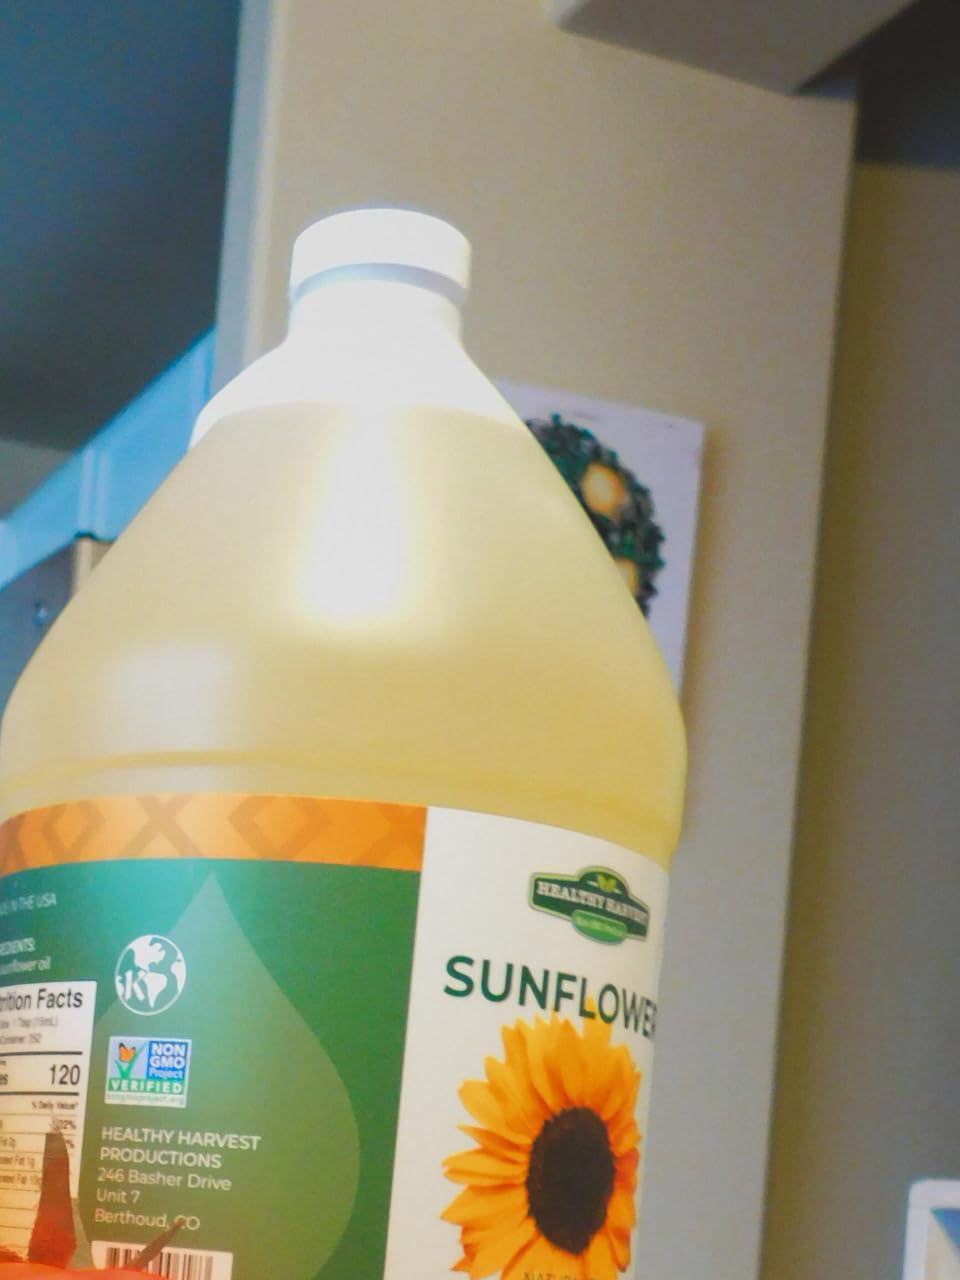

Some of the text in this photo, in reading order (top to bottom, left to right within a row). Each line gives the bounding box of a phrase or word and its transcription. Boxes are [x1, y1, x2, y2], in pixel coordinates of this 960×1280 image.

[538, 881, 606, 909] HEALTHY
[37, 988, 83, 1009] Facts
[151, 1042, 186, 1056] NON
[149, 1056, 185, 1069] GMO
[49, 1064, 80, 1086] 120
[111, 1080, 183, 1094] VERIFIED
[101, 1126, 261, 1151] HEALTHY HARVEST
[100, 1147, 222, 1169] PRODUCTIONS
[97, 1168, 232, 1191] 246 Basher Drive
[96, 1188, 140, 1204] Unit 7
[95, 1208, 201, 1231] Berthoud, CO
